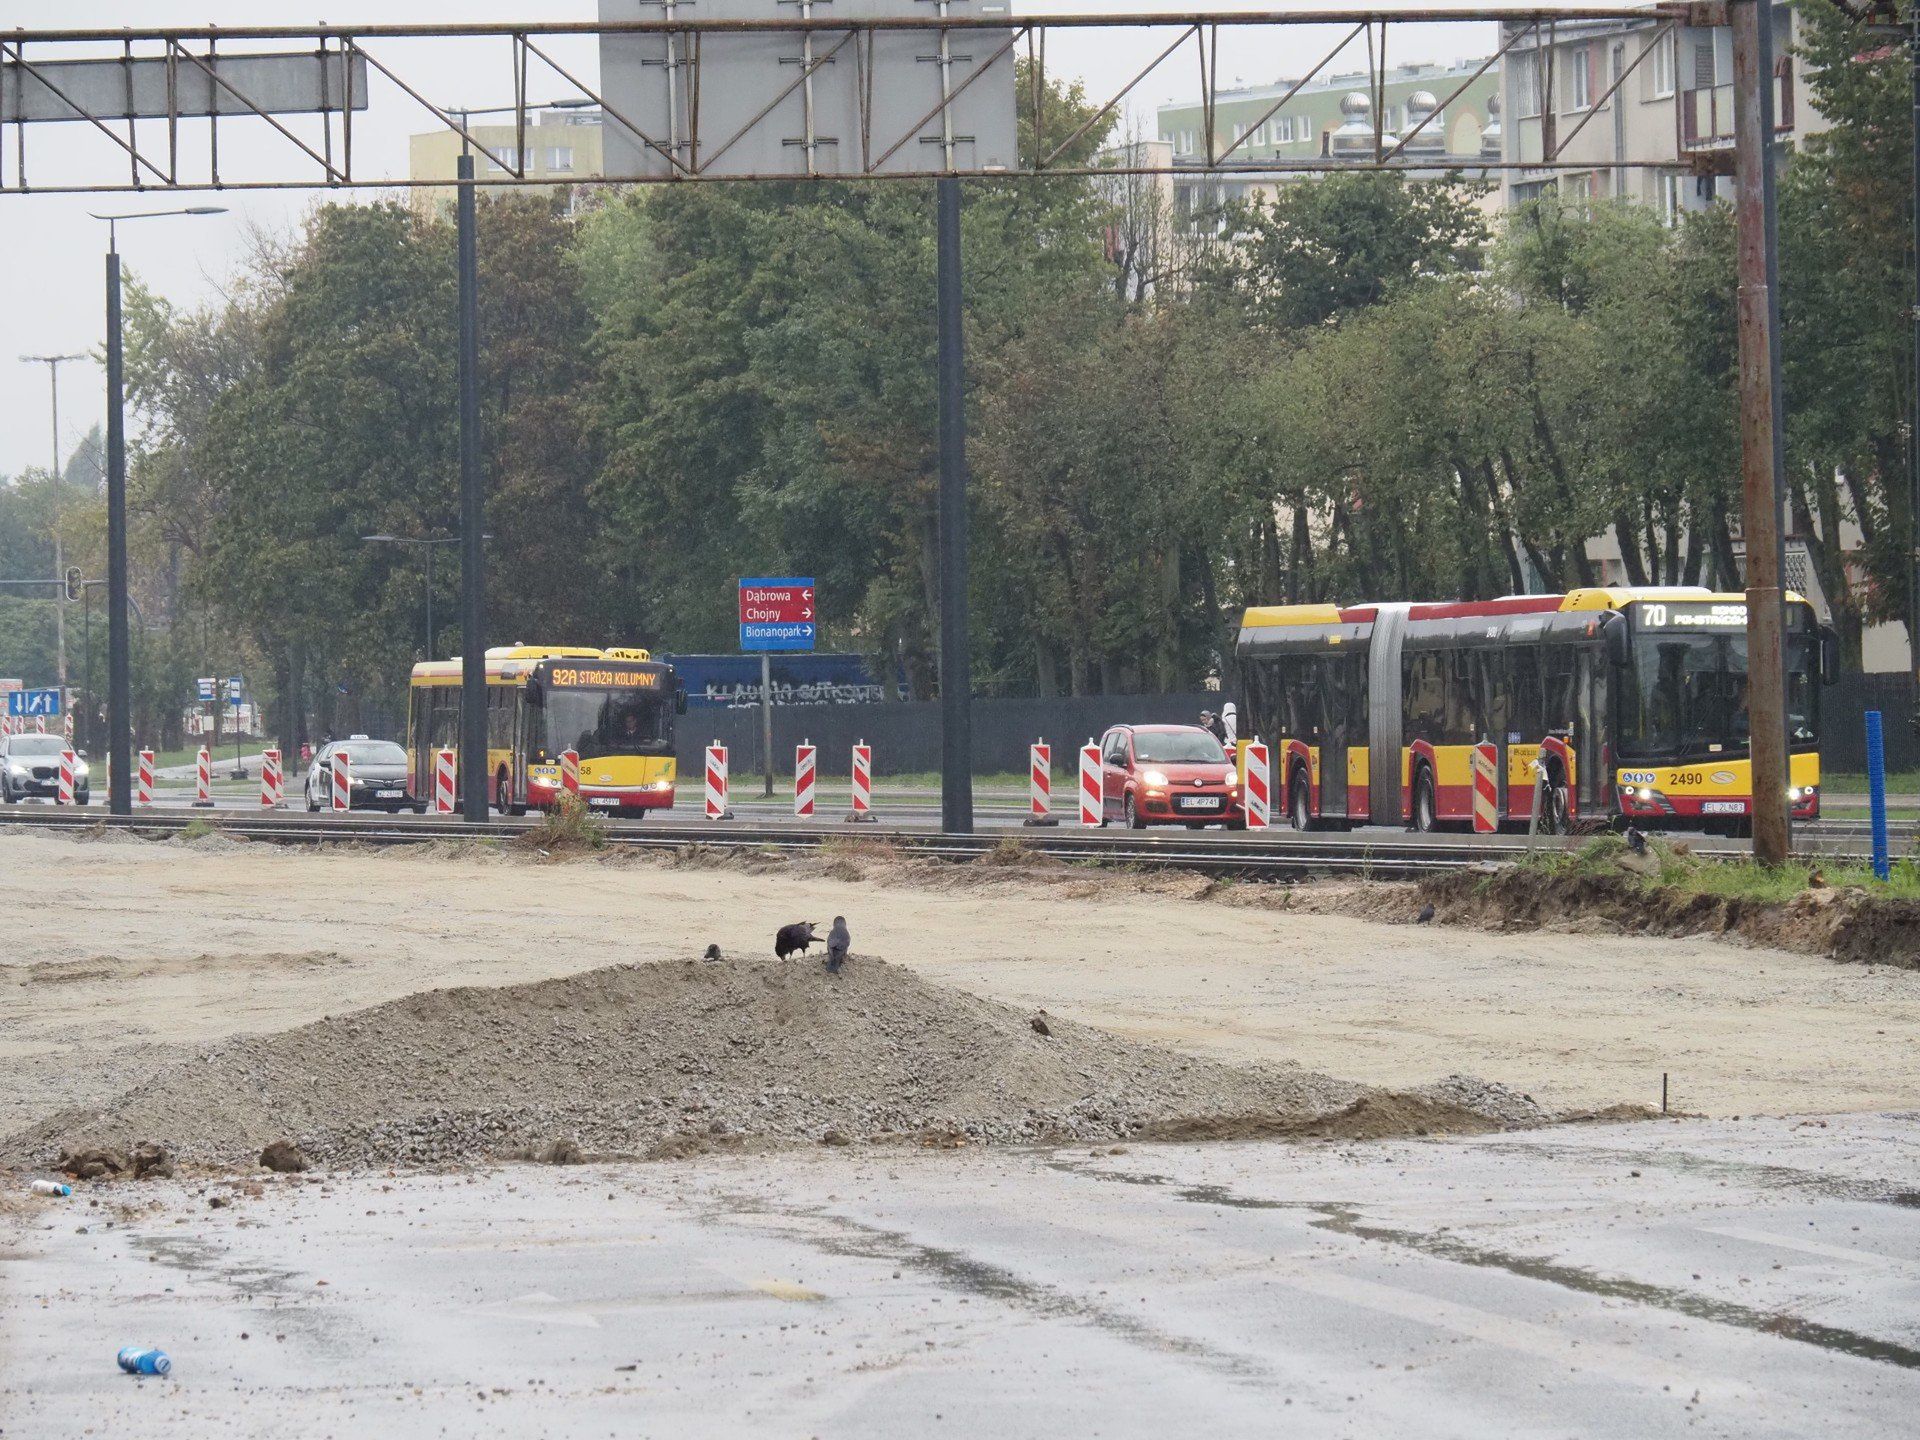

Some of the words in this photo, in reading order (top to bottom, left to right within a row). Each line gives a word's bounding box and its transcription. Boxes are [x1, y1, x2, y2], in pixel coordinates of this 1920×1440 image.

[746, 590, 791, 603] Dąbrowa
[746, 608, 780, 622] Chojny
[1643, 604, 1667, 626] 70
[746, 625, 801, 639] Bionanopark
[552, 669, 577, 686] 92A
[580, 670, 613, 685] STRÓŻA
[614, 672, 656, 686] KOLUMNY
[1670, 773, 1703, 785] 2490
[1707, 804, 1718, 812] EL
